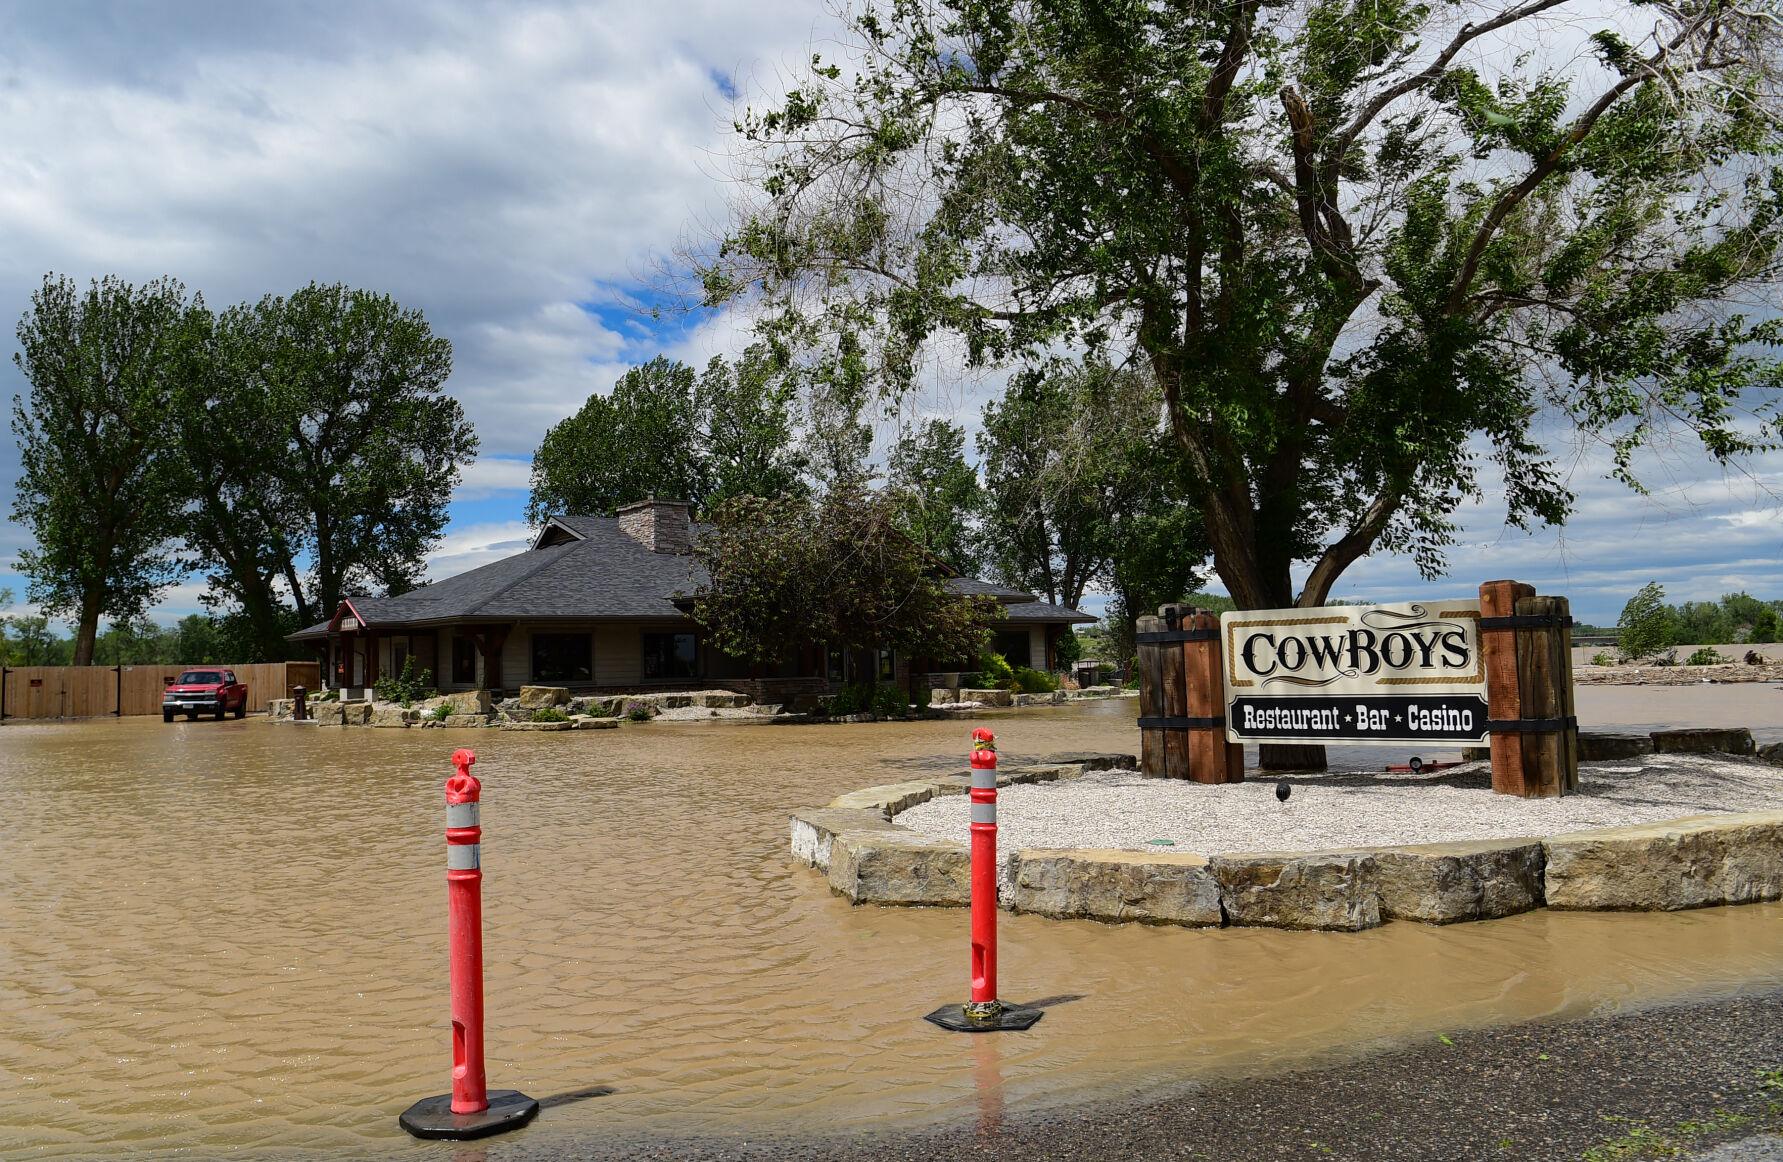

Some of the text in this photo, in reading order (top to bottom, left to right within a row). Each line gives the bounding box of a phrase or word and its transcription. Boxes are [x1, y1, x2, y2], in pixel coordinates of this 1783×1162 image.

[1243, 704, 1474, 731] Restaurant Bar Casino
